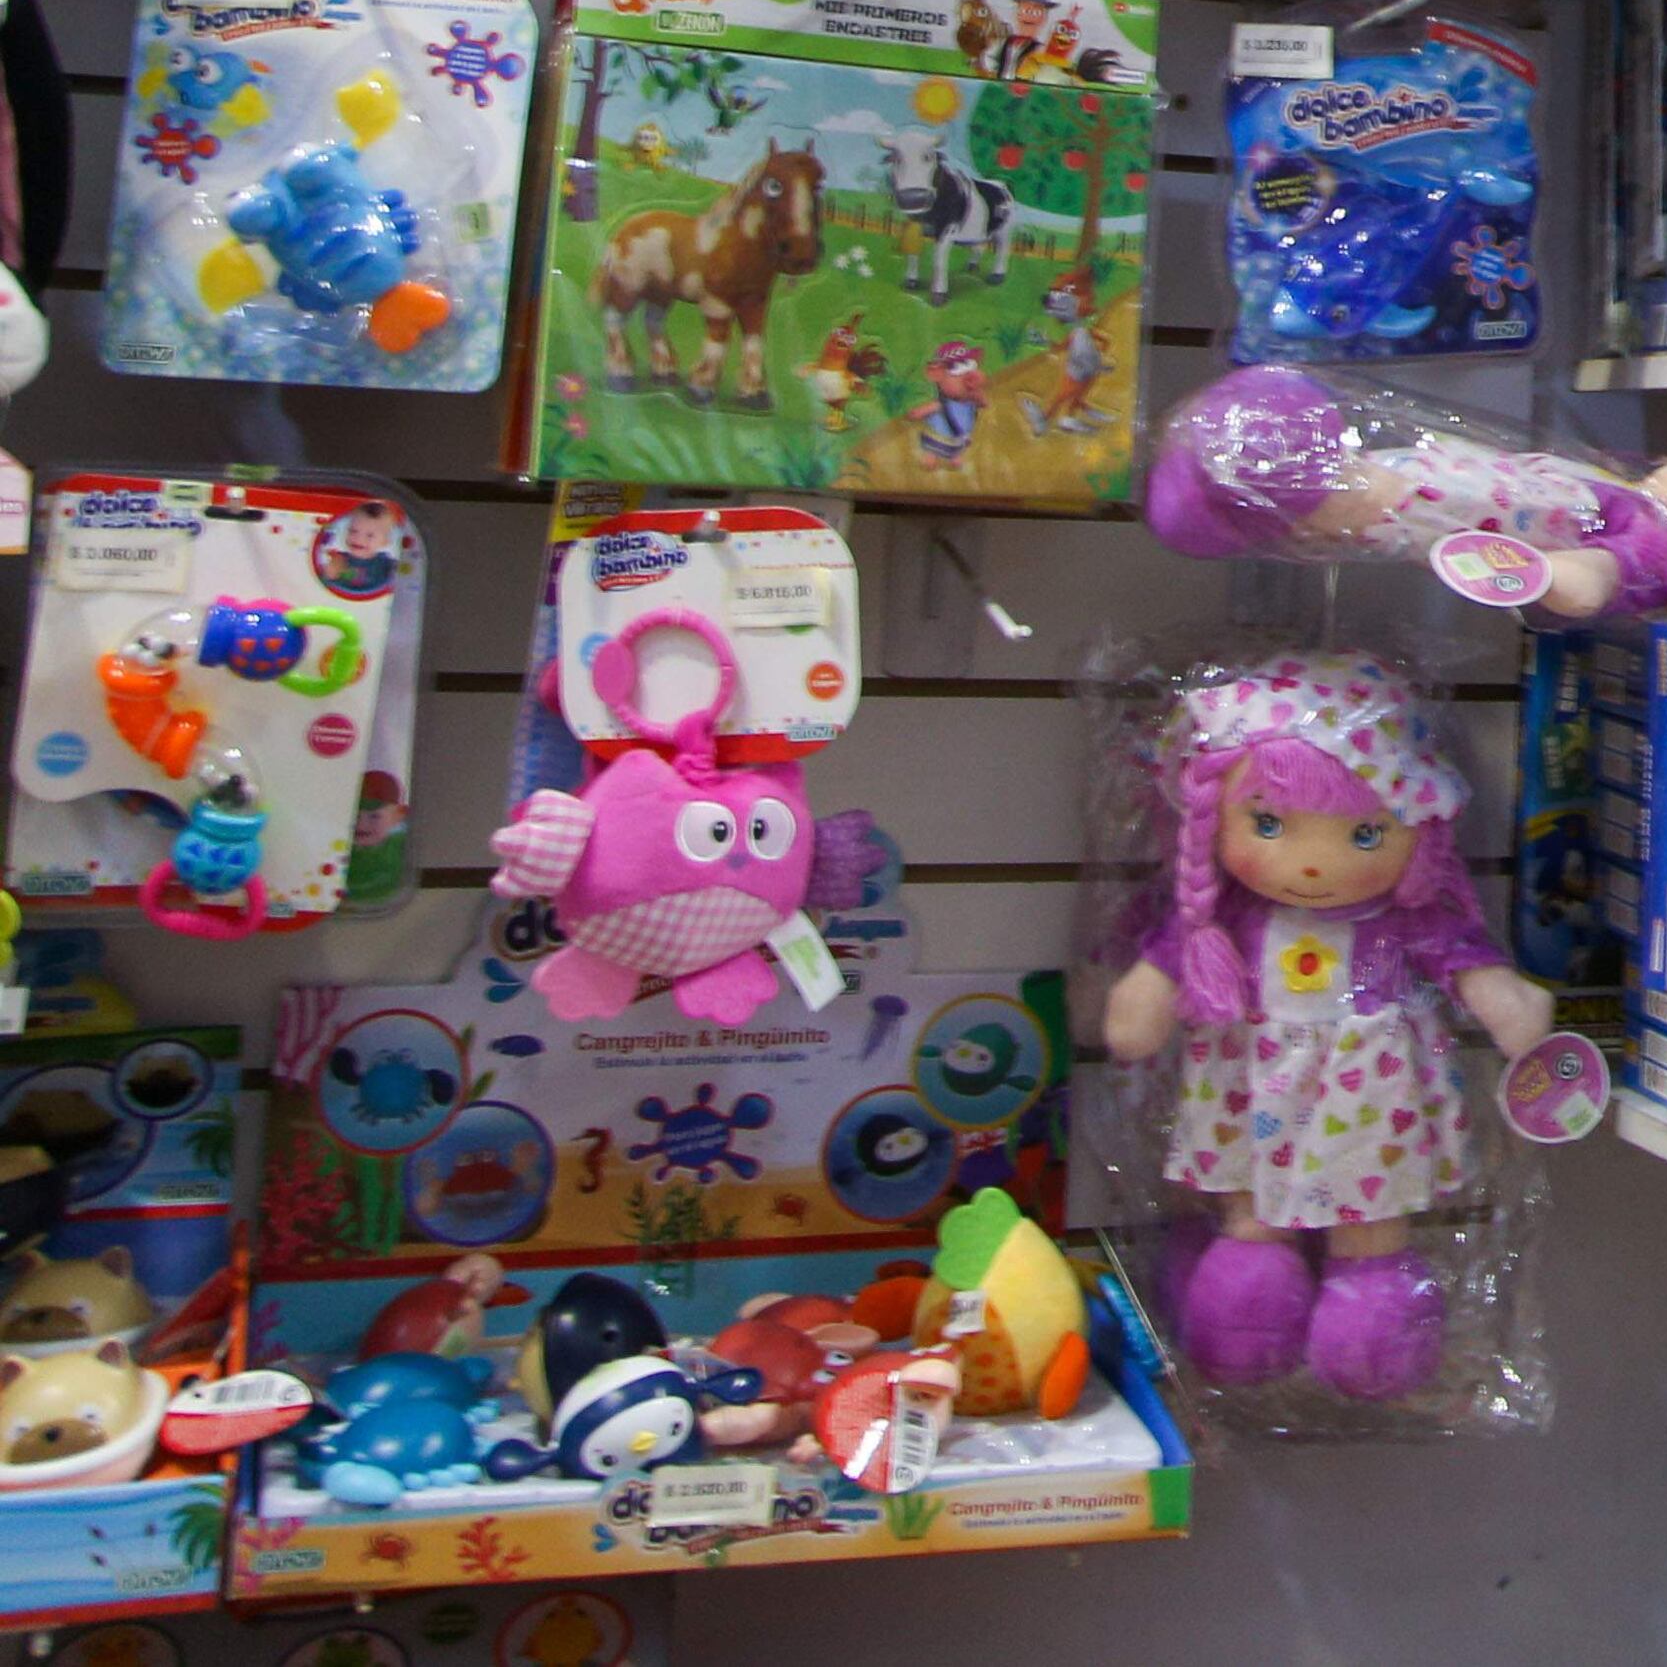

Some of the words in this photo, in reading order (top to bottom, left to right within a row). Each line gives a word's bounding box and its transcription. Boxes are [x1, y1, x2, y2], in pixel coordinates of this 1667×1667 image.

[848, 1, 949, 26] PRIMEROS
[1291, 86, 1371, 121] dolce
[1322, 95, 1449, 142] bambino
[573, 1029, 685, 1055] Cangrejito
